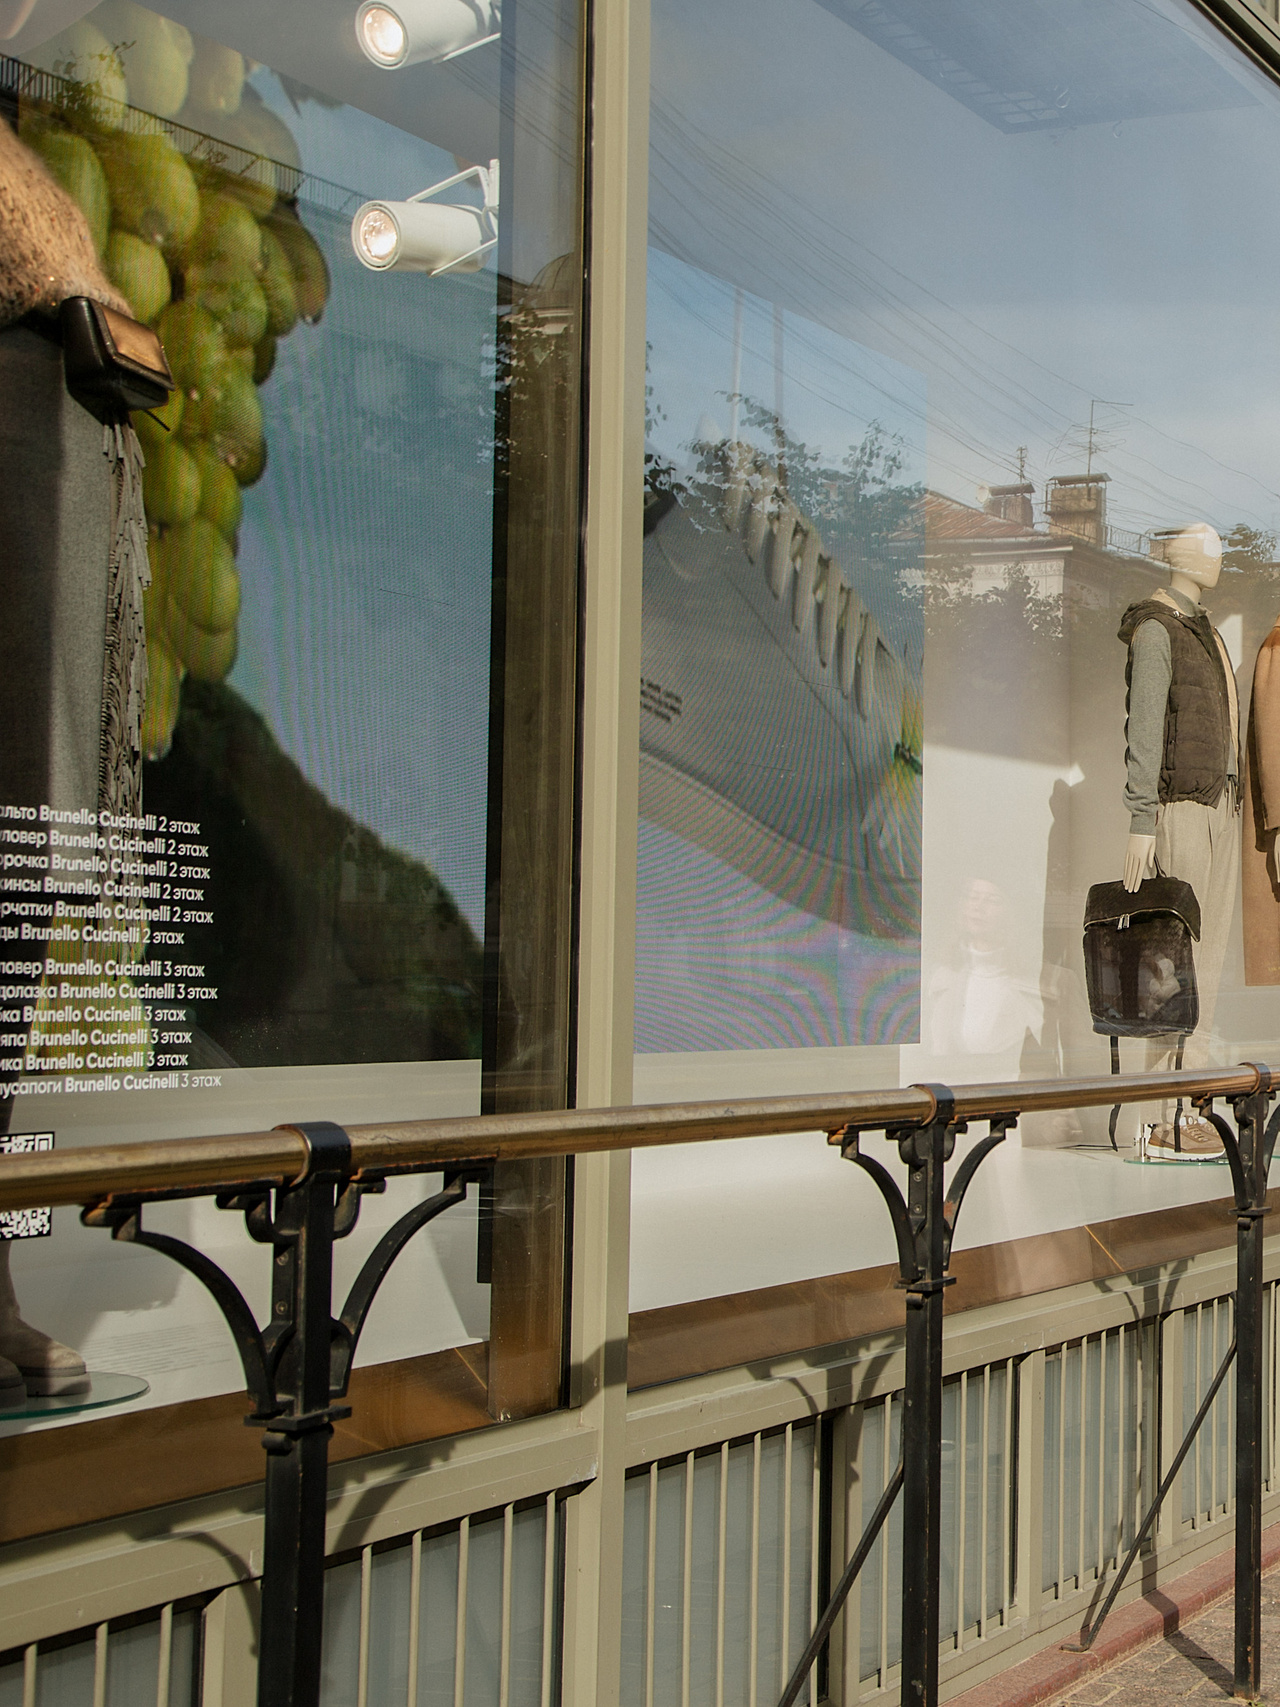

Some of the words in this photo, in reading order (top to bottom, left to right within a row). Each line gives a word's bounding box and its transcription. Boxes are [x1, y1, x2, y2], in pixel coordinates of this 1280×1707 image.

[40, 805, 96, 825] Brunello
[99, 812, 156, 830] Cucinelli
[159, 816, 167, 831] 2
[169, 823, 200, 834] этаж
[0, 830, 47, 848] ловер
[49, 831, 105, 849] Brunello
[109, 835, 165, 854] Cucinelli
[168, 840, 176, 854] 2
[178, 845, 208, 857] этаж
[52, 854, 107, 872] Brunello
[111, 858, 167, 876] Cucinelli
[169, 862, 177, 877] 2
[180, 866, 210, 879] этаж
[44, 877, 100, 895] Brunello
[104, 881, 160, 899] Cucinelli
[163, 885, 171, 899] 2
[173, 888, 204, 901] этаж
[0, 901, 52, 918] рчатки
[55, 901, 111, 918] Brunello
[115, 904, 170, 922] Cucinelli
[173, 907, 181, 922] 2
[183, 911, 213, 923] этаж
[22, 924, 79, 941] Brunello
[82, 926, 140, 943] Cucinelli
[143, 928, 151, 943] 2
[153, 932, 184, 944] этаж
[45, 958, 101, 975] Brunello
[105, 959, 161, 976] Cucinelli
[164, 962, 172, 976] 3
[174, 965, 205, 977] этаж
[61, 983, 116, 999] Brunello
[119, 984, 175, 999] Cucinelli
[178, 984, 185, 999] 3
[188, 987, 218, 999] этаж
[0, 1008, 20, 1022] ка
[23, 1006, 81, 1022] Brunello
[84, 1006, 141, 1022] Cucinelli
[144, 1006, 152, 1021] 3
[155, 1009, 186, 1021] этаж
[30, 1030, 88, 1046] Brunello
[90, 1029, 147, 1045] Cucinelli
[151, 1029, 159, 1044] 3
[161, 1031, 192, 1044] этаж
[26, 1054, 83, 1070] Brunello
[87, 1052, 143, 1068] Cucinelli
[147, 1051, 155, 1066] 3
[157, 1054, 188, 1066] этаж
[65, 1077, 120, 1093] Brunello
[123, 1074, 179, 1090] Cucinelli
[181, 1074, 189, 1088] 3
[192, 1074, 221, 1087] этаж
